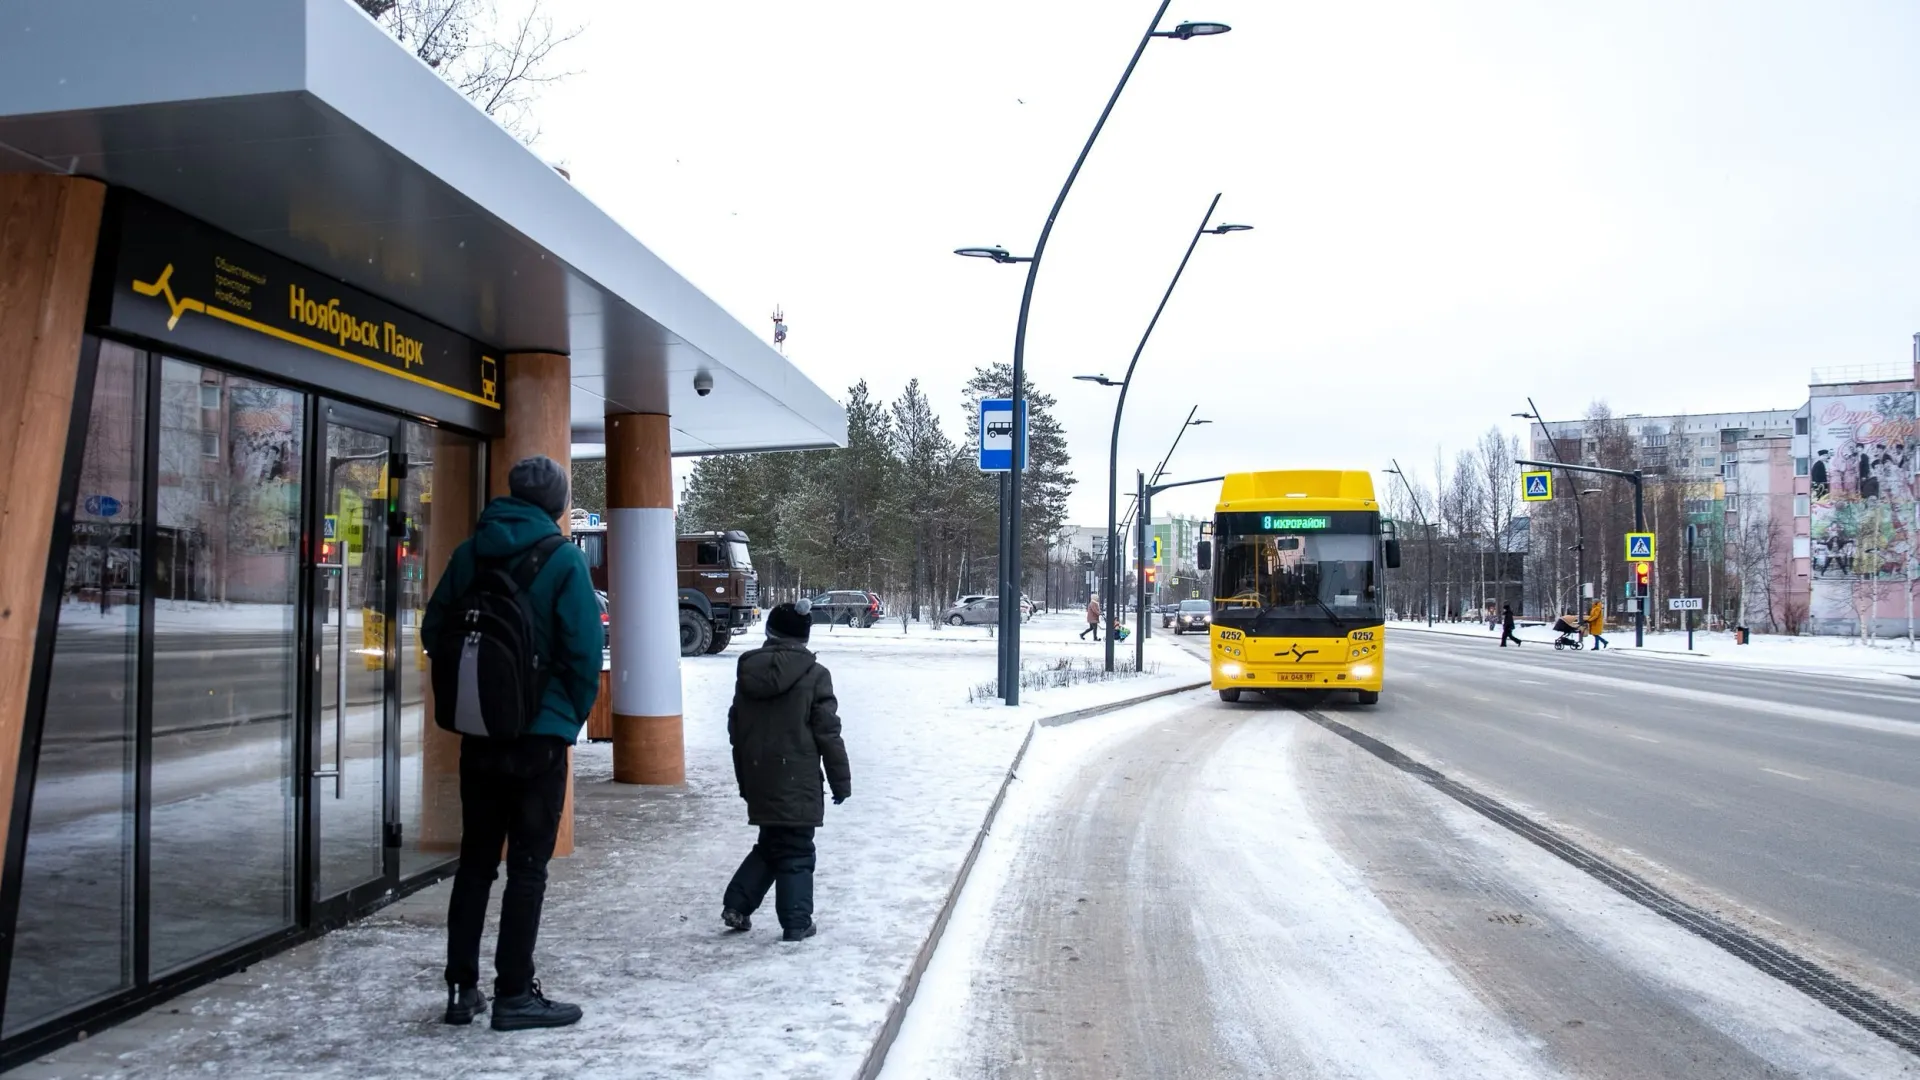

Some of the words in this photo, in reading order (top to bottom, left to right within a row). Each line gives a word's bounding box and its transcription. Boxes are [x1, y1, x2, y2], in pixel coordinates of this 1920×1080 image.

[215, 256, 267, 285] Общественный
[289, 283, 380, 350] Ноябрьск
[383, 321, 424, 369] Парк
[1264, 516, 1272, 530] 8
[1673, 600, 1698, 609] СТОП
[1220, 630, 1242, 641] 4252
[1352, 631, 1374, 641] 4252
